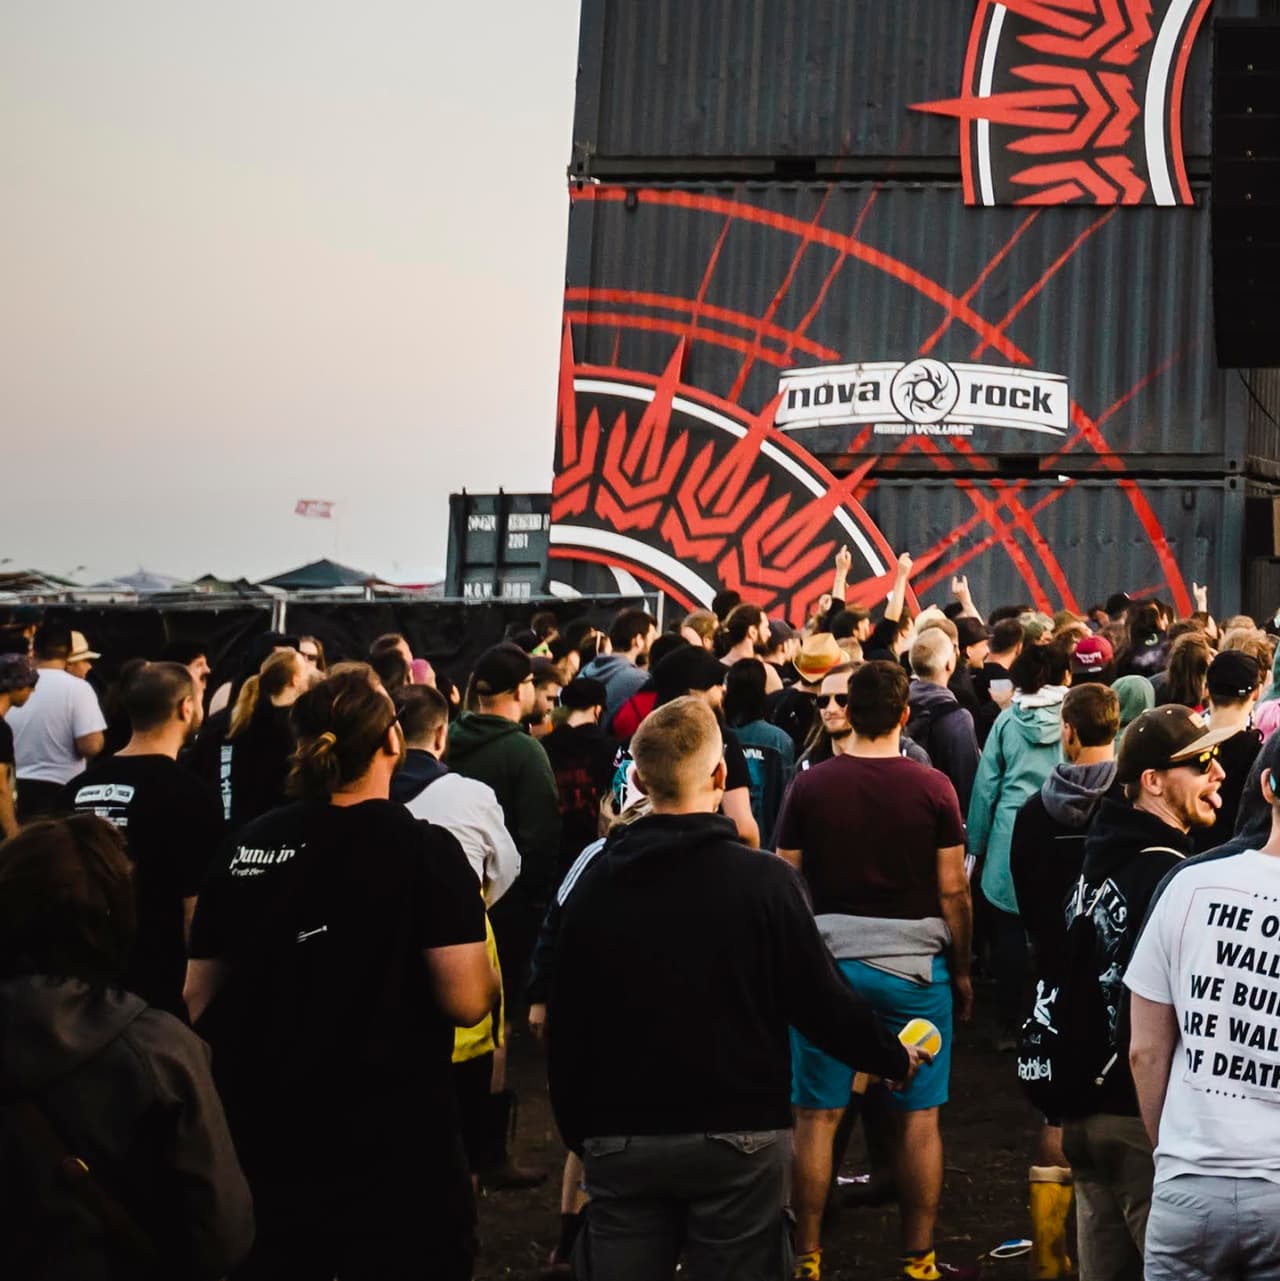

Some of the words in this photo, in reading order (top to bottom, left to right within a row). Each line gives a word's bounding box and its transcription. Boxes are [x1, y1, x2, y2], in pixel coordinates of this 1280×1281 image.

[787, 381, 881, 409] nova
[970, 383, 1053, 415] rock
[1207, 902, 1253, 932] THE
[1191, 974, 1225, 1001] WE
